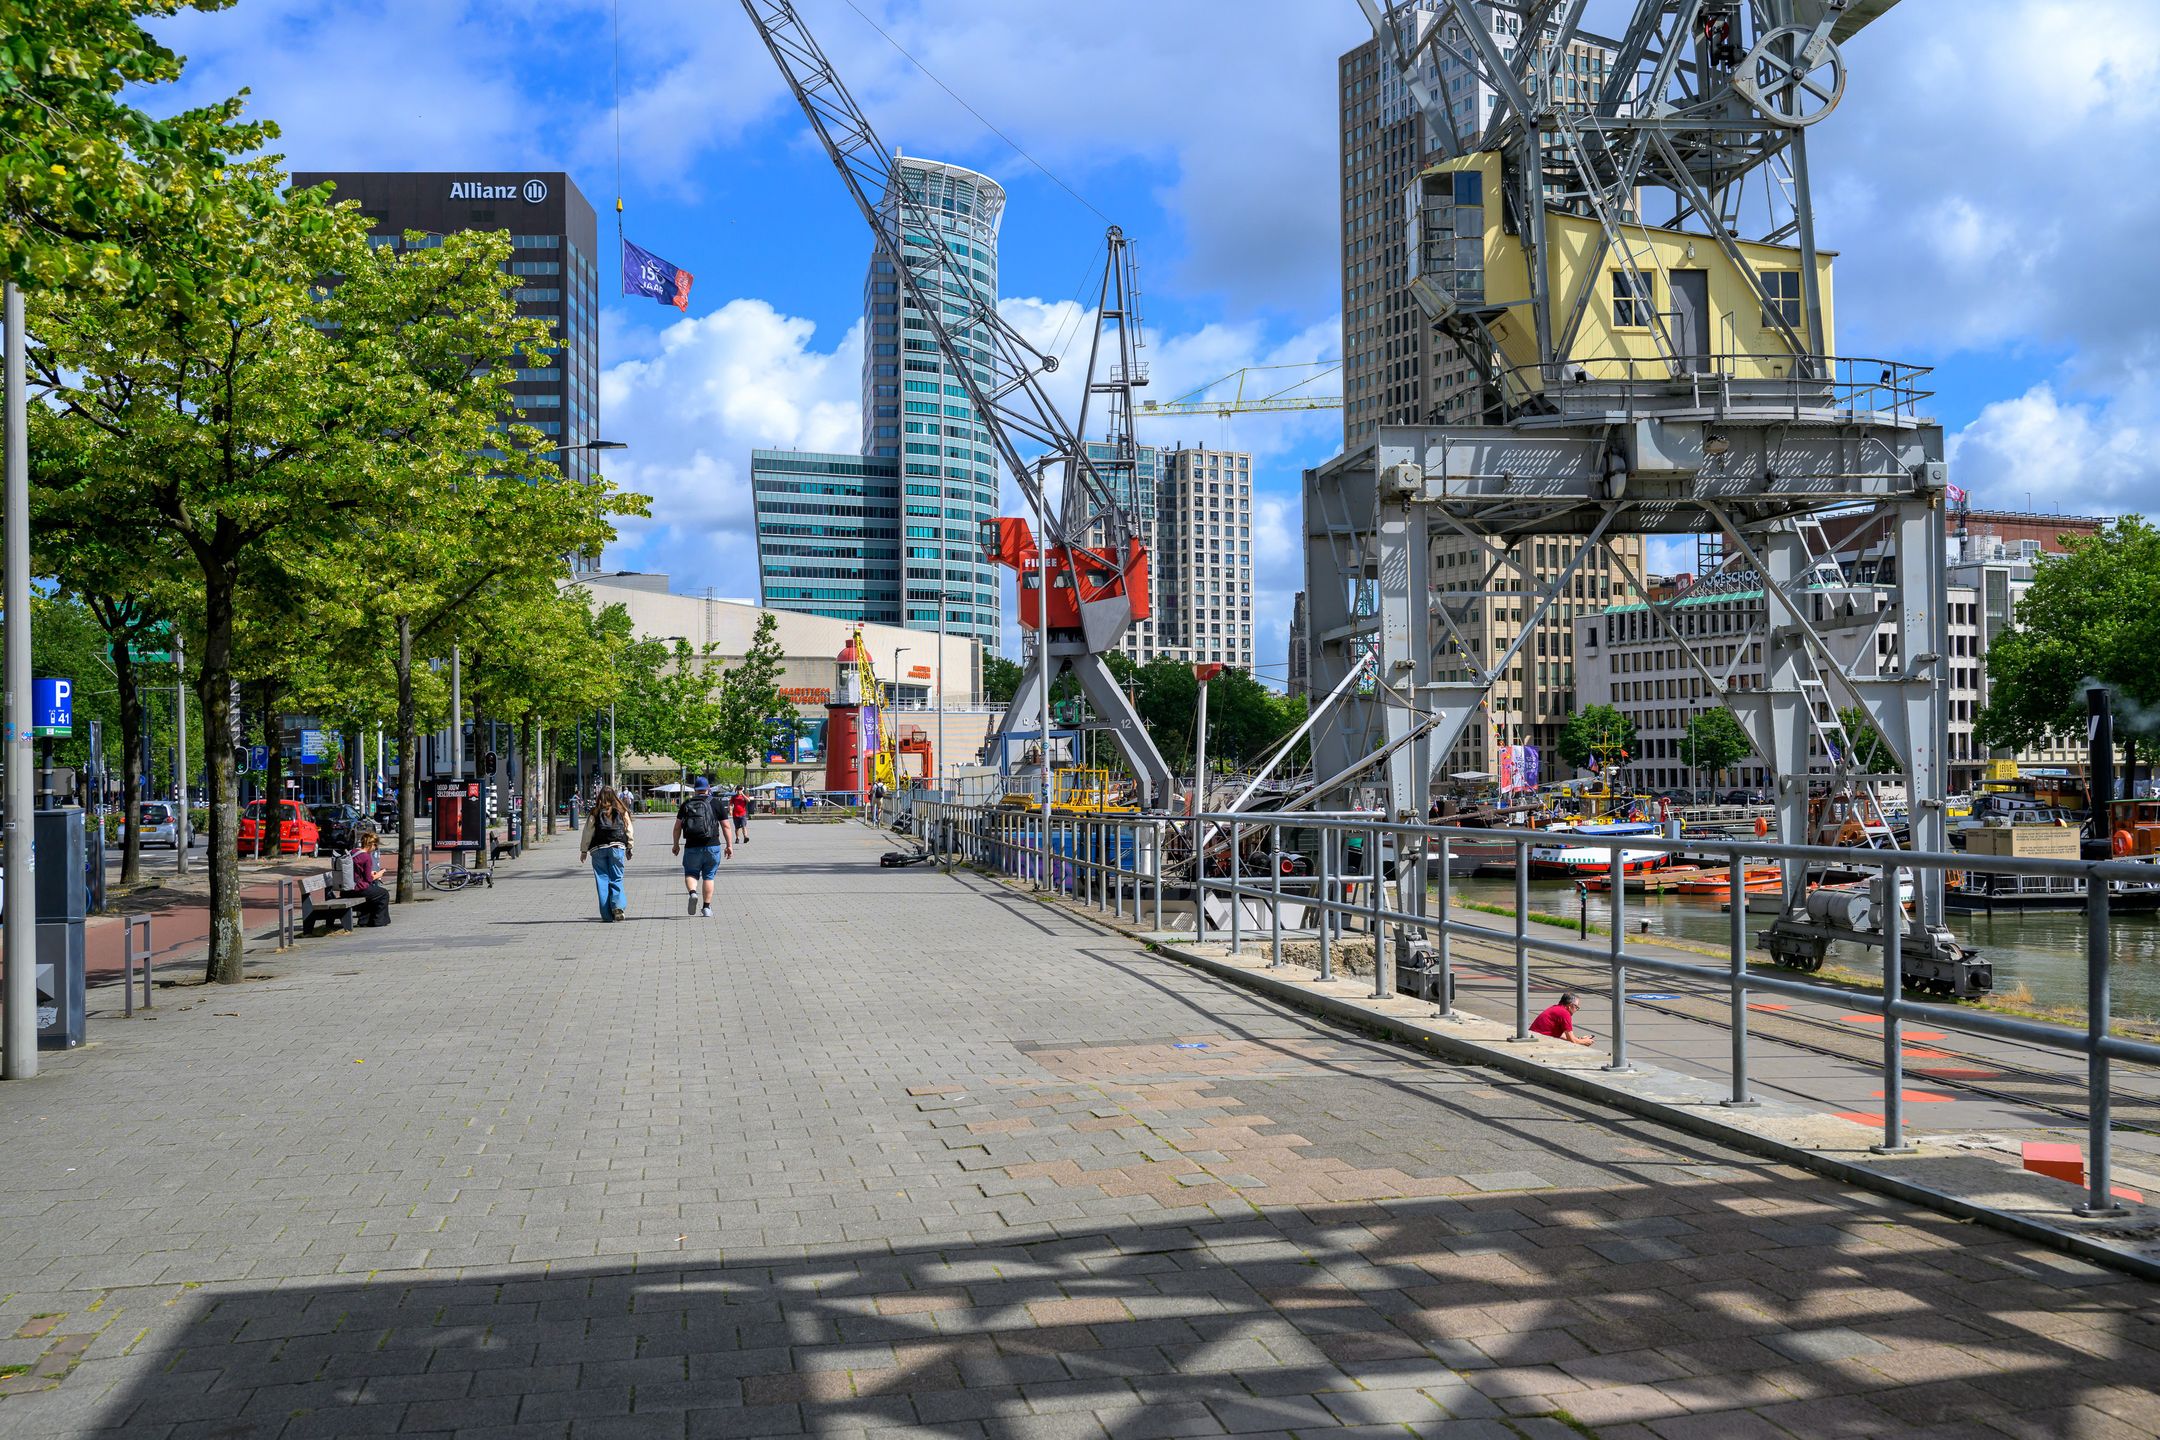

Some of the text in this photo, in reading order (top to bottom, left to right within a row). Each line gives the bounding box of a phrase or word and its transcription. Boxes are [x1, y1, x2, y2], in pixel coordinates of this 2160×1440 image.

[450, 182, 517, 199] Allianz
[640, 265, 665, 284] 150
[640, 281, 664, 295] JAAR
[55, 681, 70, 708] P
[779, 687, 831, 696] MARITIEM
[58, 712, 70, 724] 41
[1121, 718, 1132, 729] 12
[255, 747, 265, 760] P
